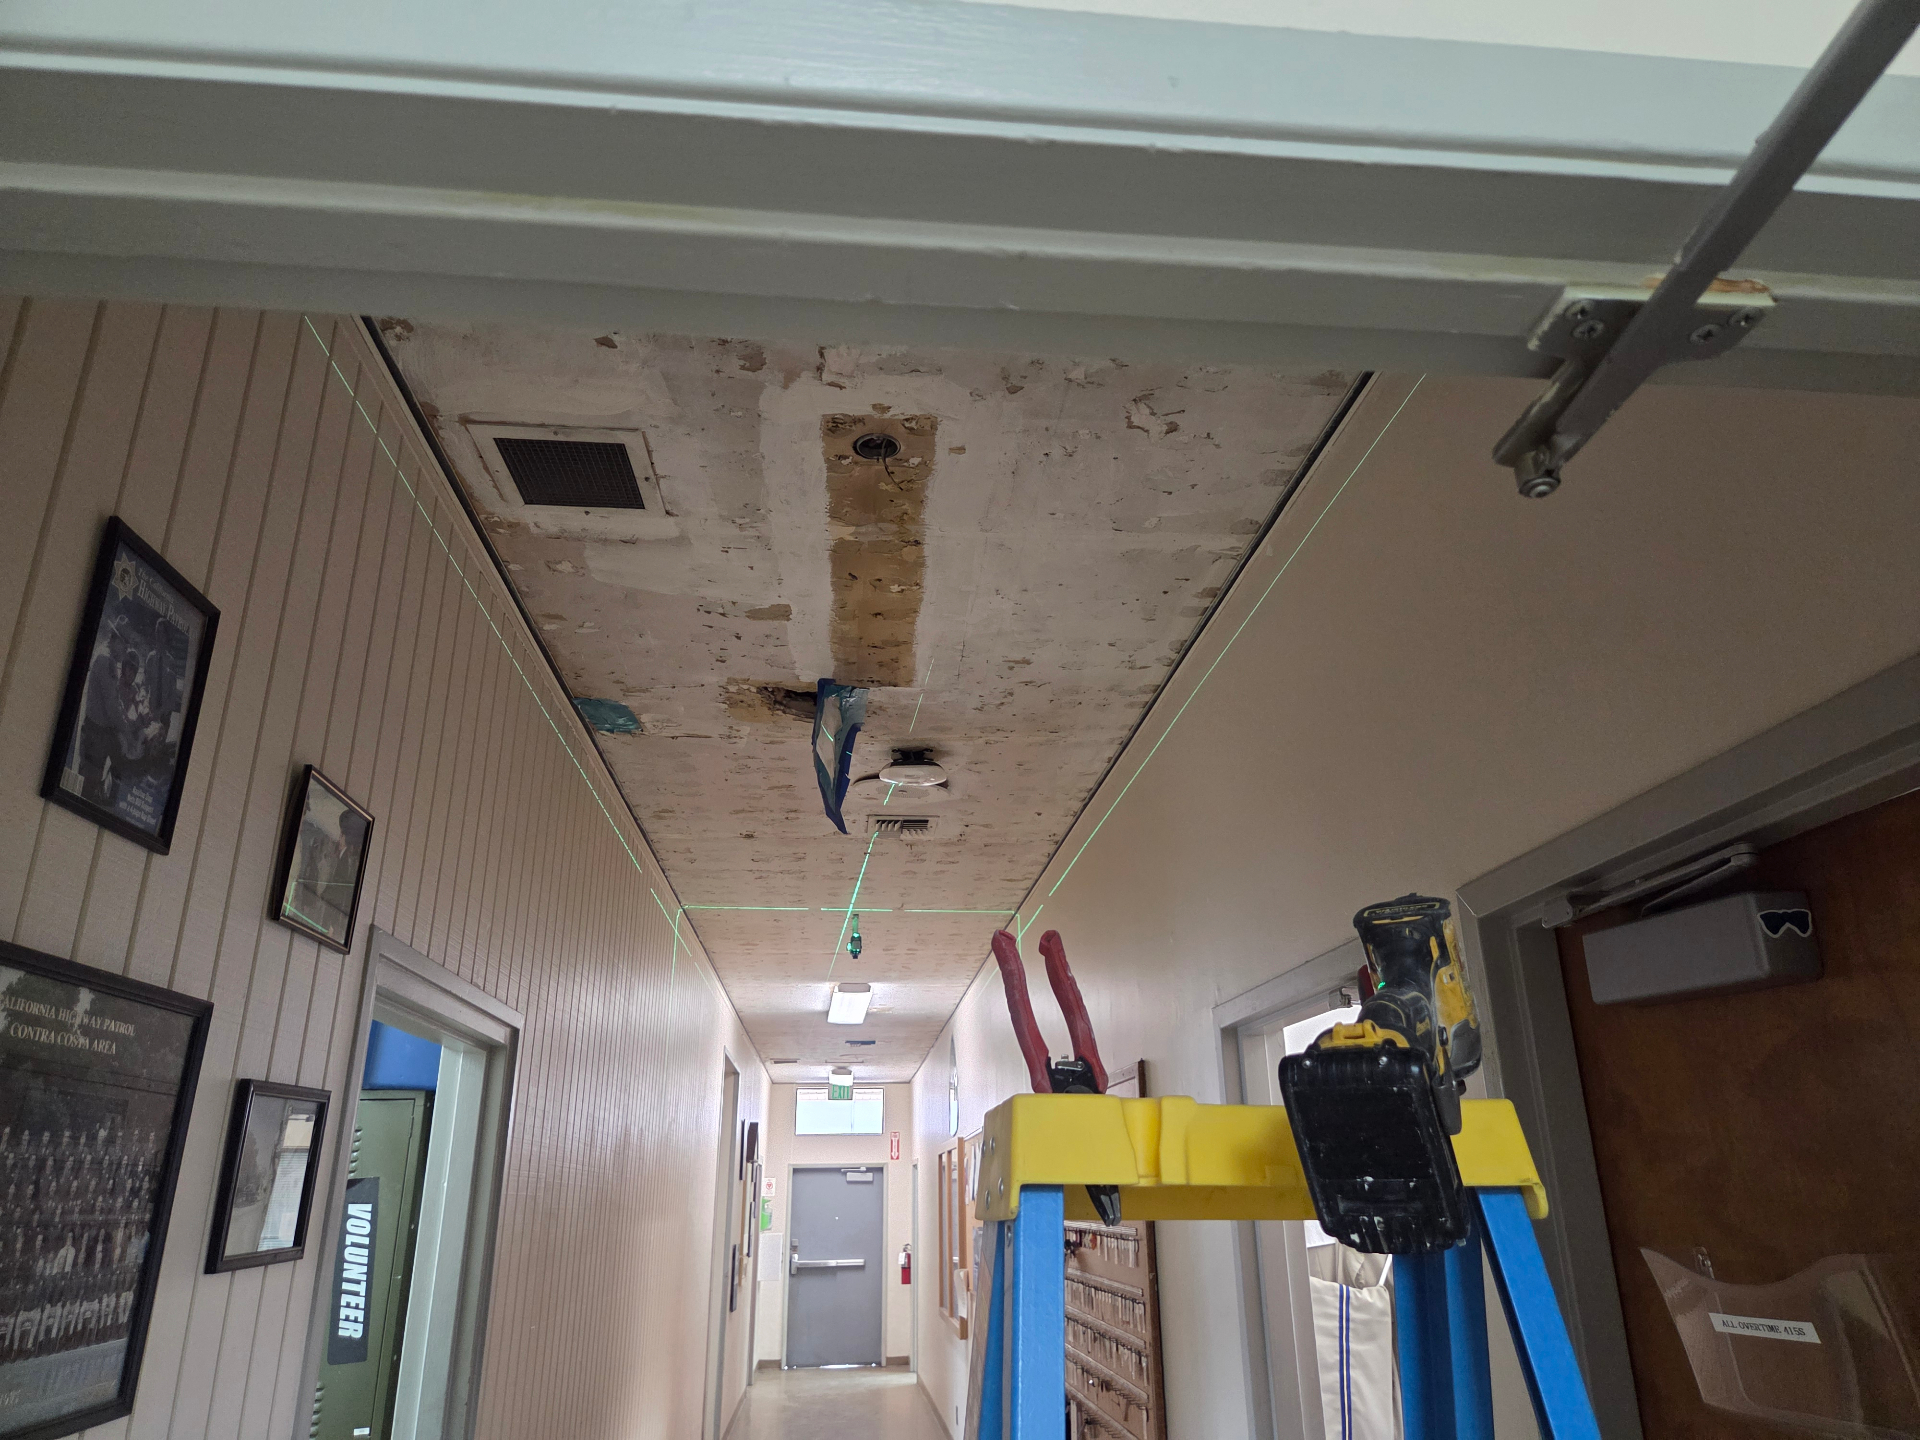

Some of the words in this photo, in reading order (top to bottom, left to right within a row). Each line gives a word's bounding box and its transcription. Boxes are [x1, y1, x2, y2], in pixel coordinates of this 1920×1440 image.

[59, 1009, 102, 1029] HIGHWAY
[104, 1018, 135, 1036] PATROL
[10, 1022, 55, 1044] CONTRA
[57, 1031, 90, 1050] COSTA
[91, 1039, 115, 1054] AREA
[832, 1084, 850, 1099] EXIT
[338, 1204, 372, 1339] VOLUNTEER
[1722, 1320, 1737, 1328] ALL
[1739, 1321, 1782, 1333] OVERTIME
